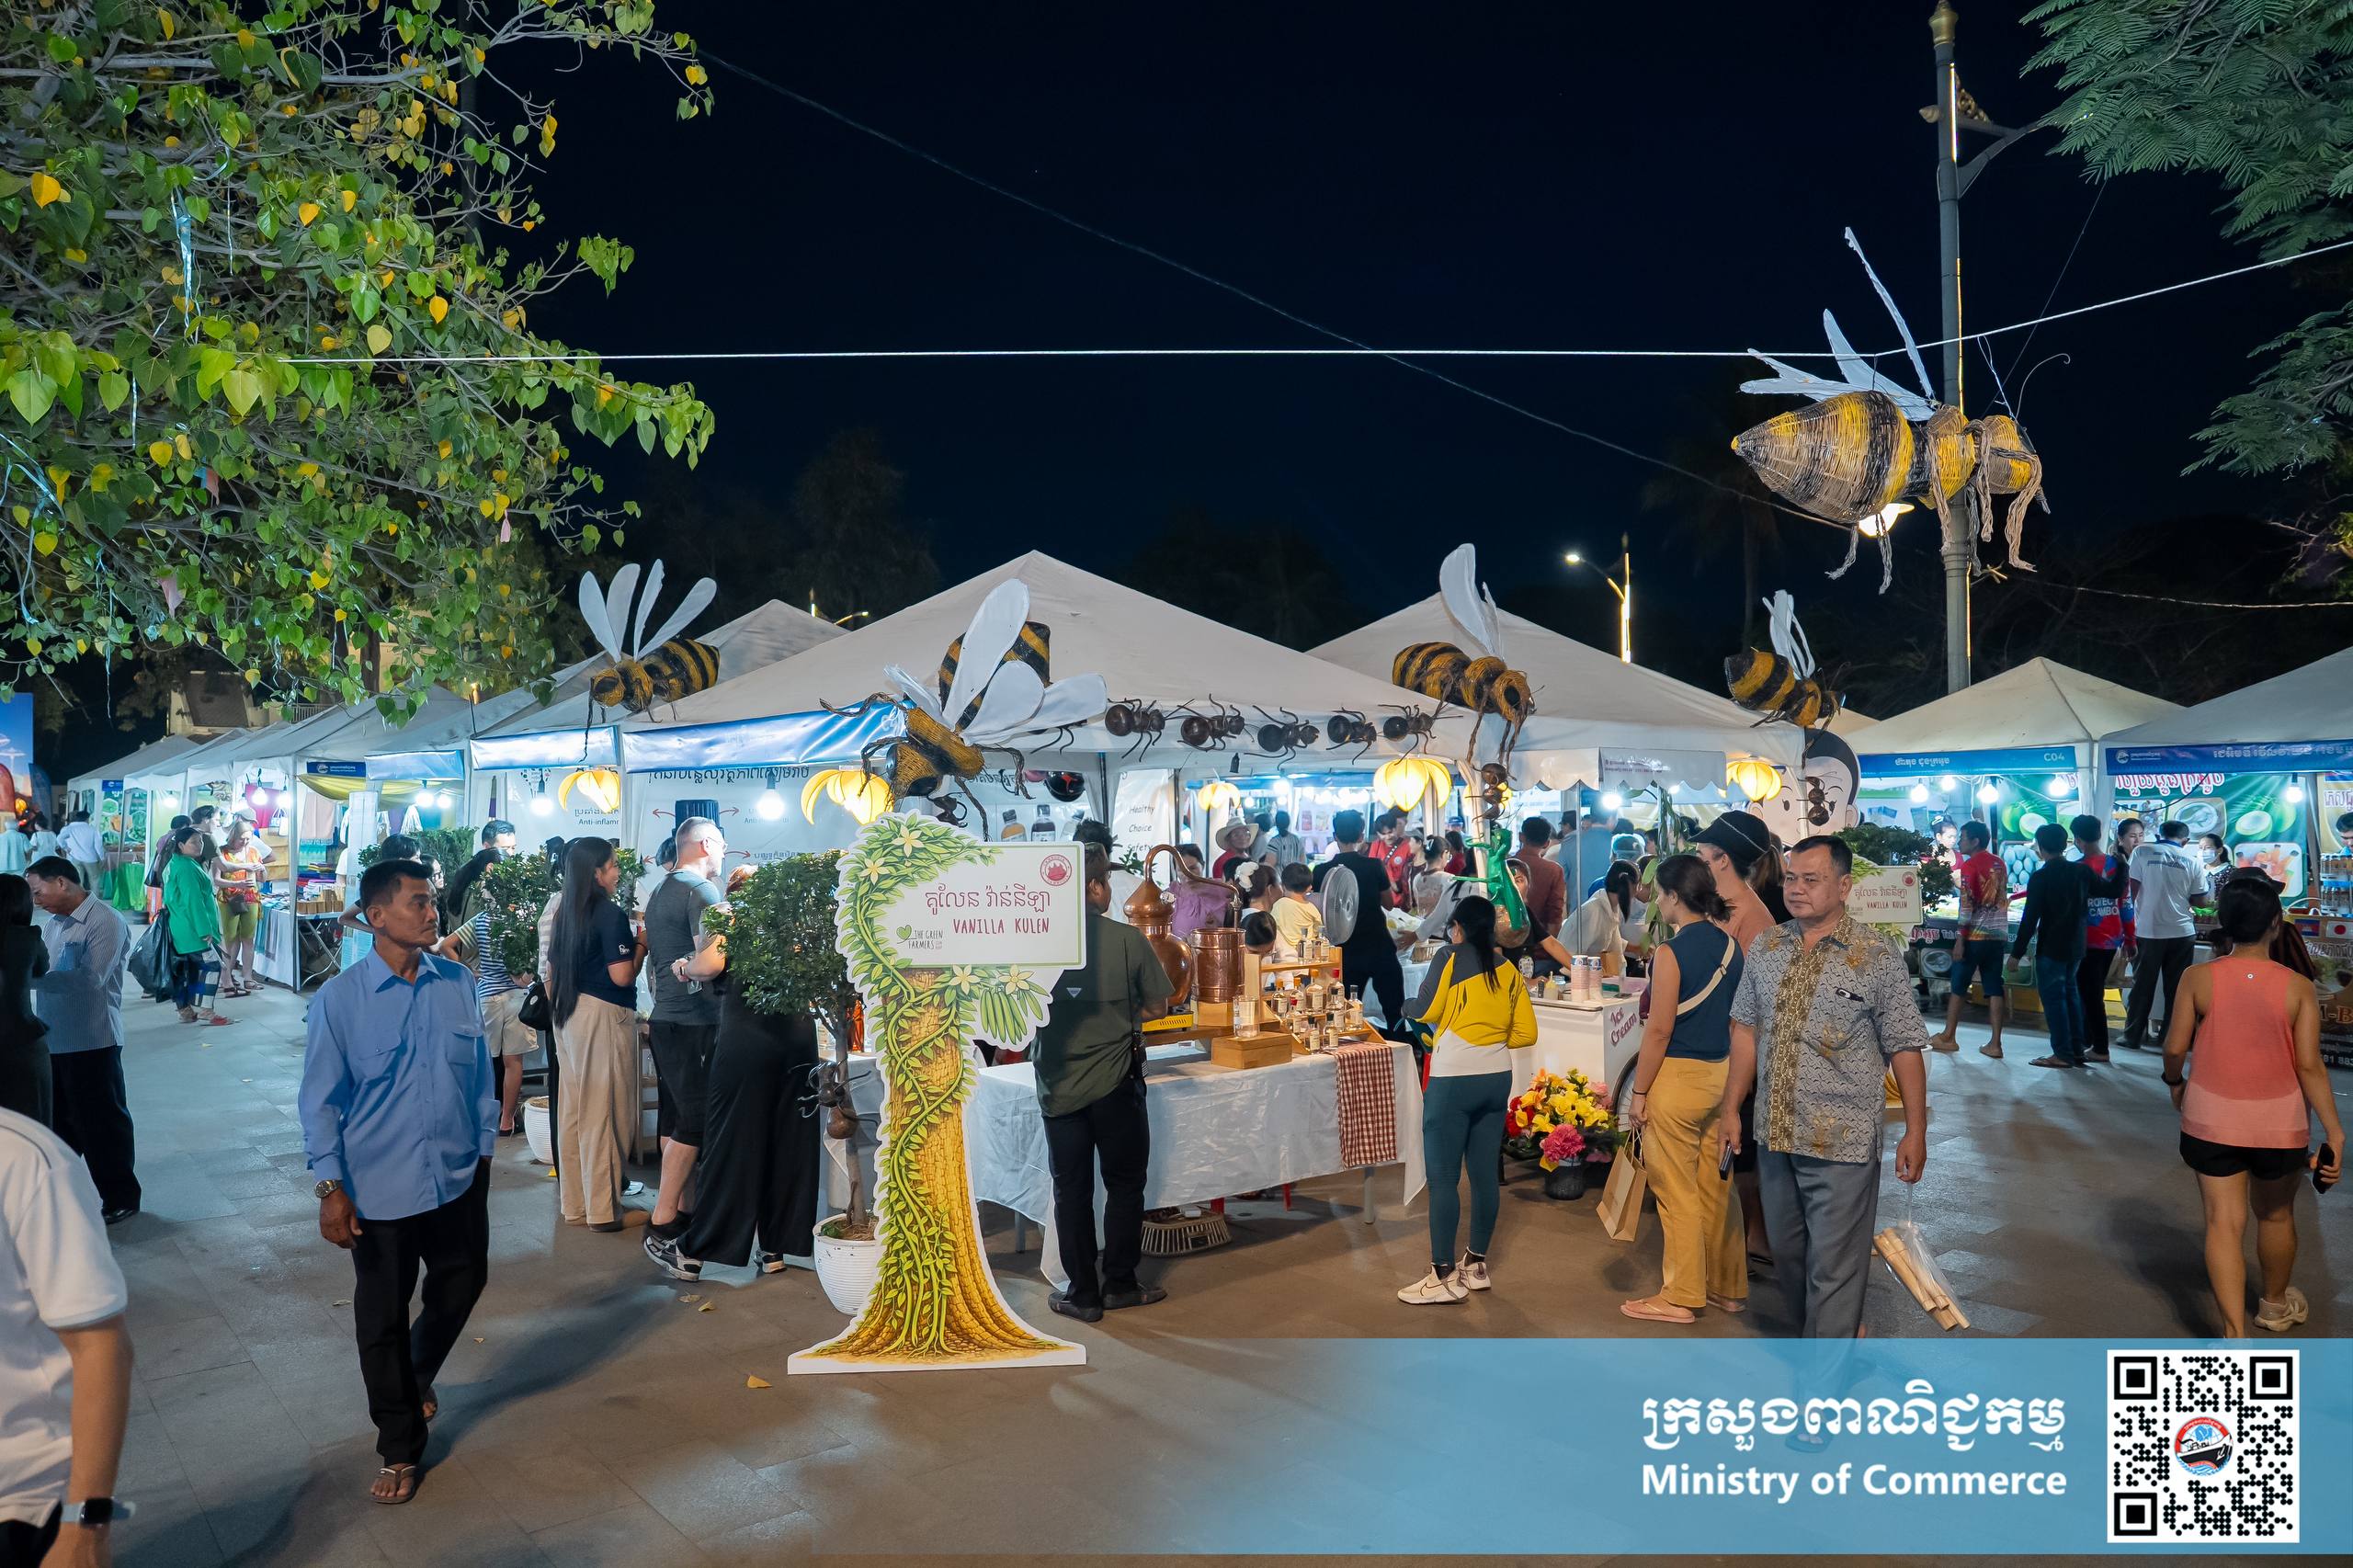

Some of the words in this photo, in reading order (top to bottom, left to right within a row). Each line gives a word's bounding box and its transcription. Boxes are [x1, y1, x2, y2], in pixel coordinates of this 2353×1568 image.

[2043, 752, 2065, 762] C04
[1129, 803, 1155, 815] Healthy
[1129, 824, 1153, 833] Choice
[1866, 901, 1889, 909] VANILLA
[952, 919, 1006, 935] VANILLA
[1015, 918, 1050, 934] KULEN
[925, 930, 943, 939] GREEN
[908, 940, 935, 949] FARMERS
[1610, 1007, 1624, 1026] Ice
[1610, 1013, 1638, 1047] Cream
